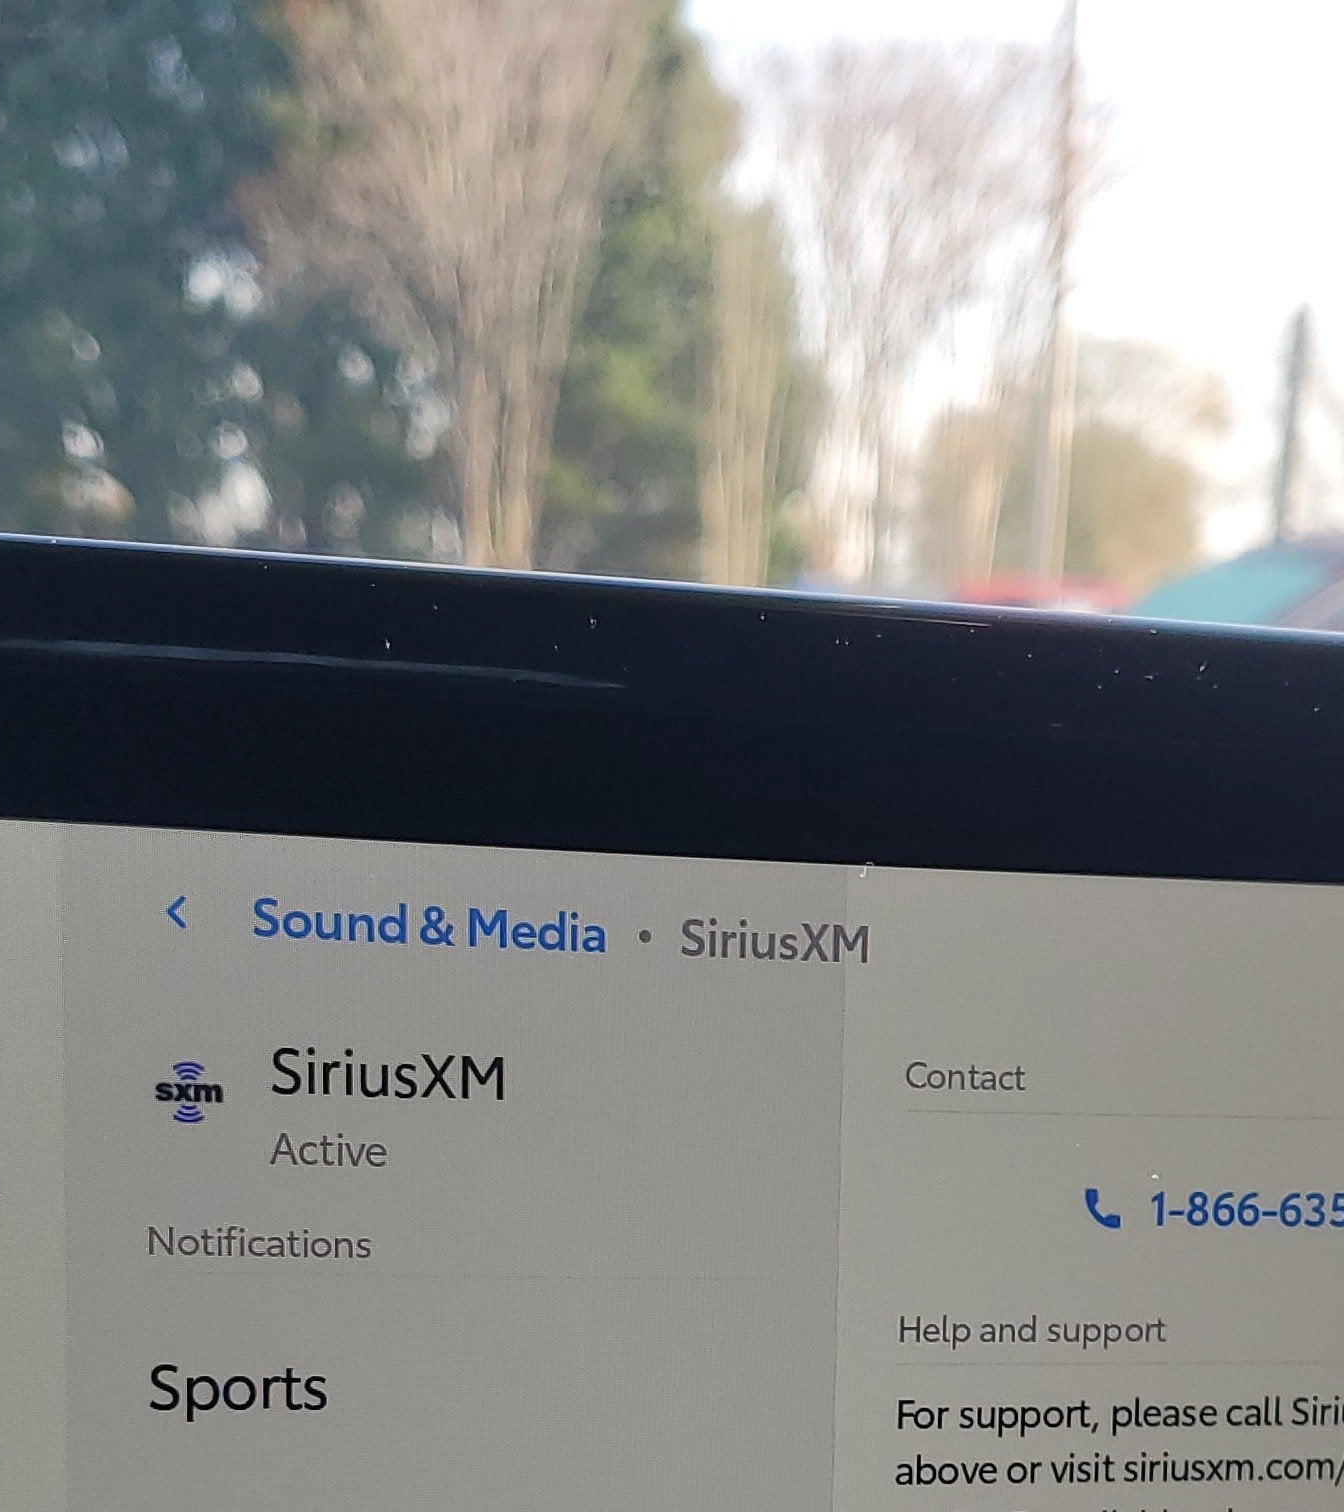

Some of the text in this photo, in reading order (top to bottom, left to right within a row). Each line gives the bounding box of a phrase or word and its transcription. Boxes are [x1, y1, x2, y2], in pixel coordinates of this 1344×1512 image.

[253, 897, 869, 964] Sound & Media SiriusXM
[271, 1046, 504, 1101] SiriusXM
[905, 1061, 1027, 1092] Contact
[155, 1082, 224, 1103] sxm
[269, 1132, 388, 1168] Active
[148, 1225, 372, 1259] Notifications
[899, 1314, 1168, 1351] Help and support
[149, 1363, 329, 1422] Sports
[897, 1399, 950, 1430] For
[959, 1399, 1099, 1438] support,
[1112, 1396, 1218, 1437] please
[1225, 1395, 1283, 1427] call
[895, 1453, 998, 1486] above
[1006, 1461, 1043, 1484] or
[1050, 1452, 1116, 1484] visit
